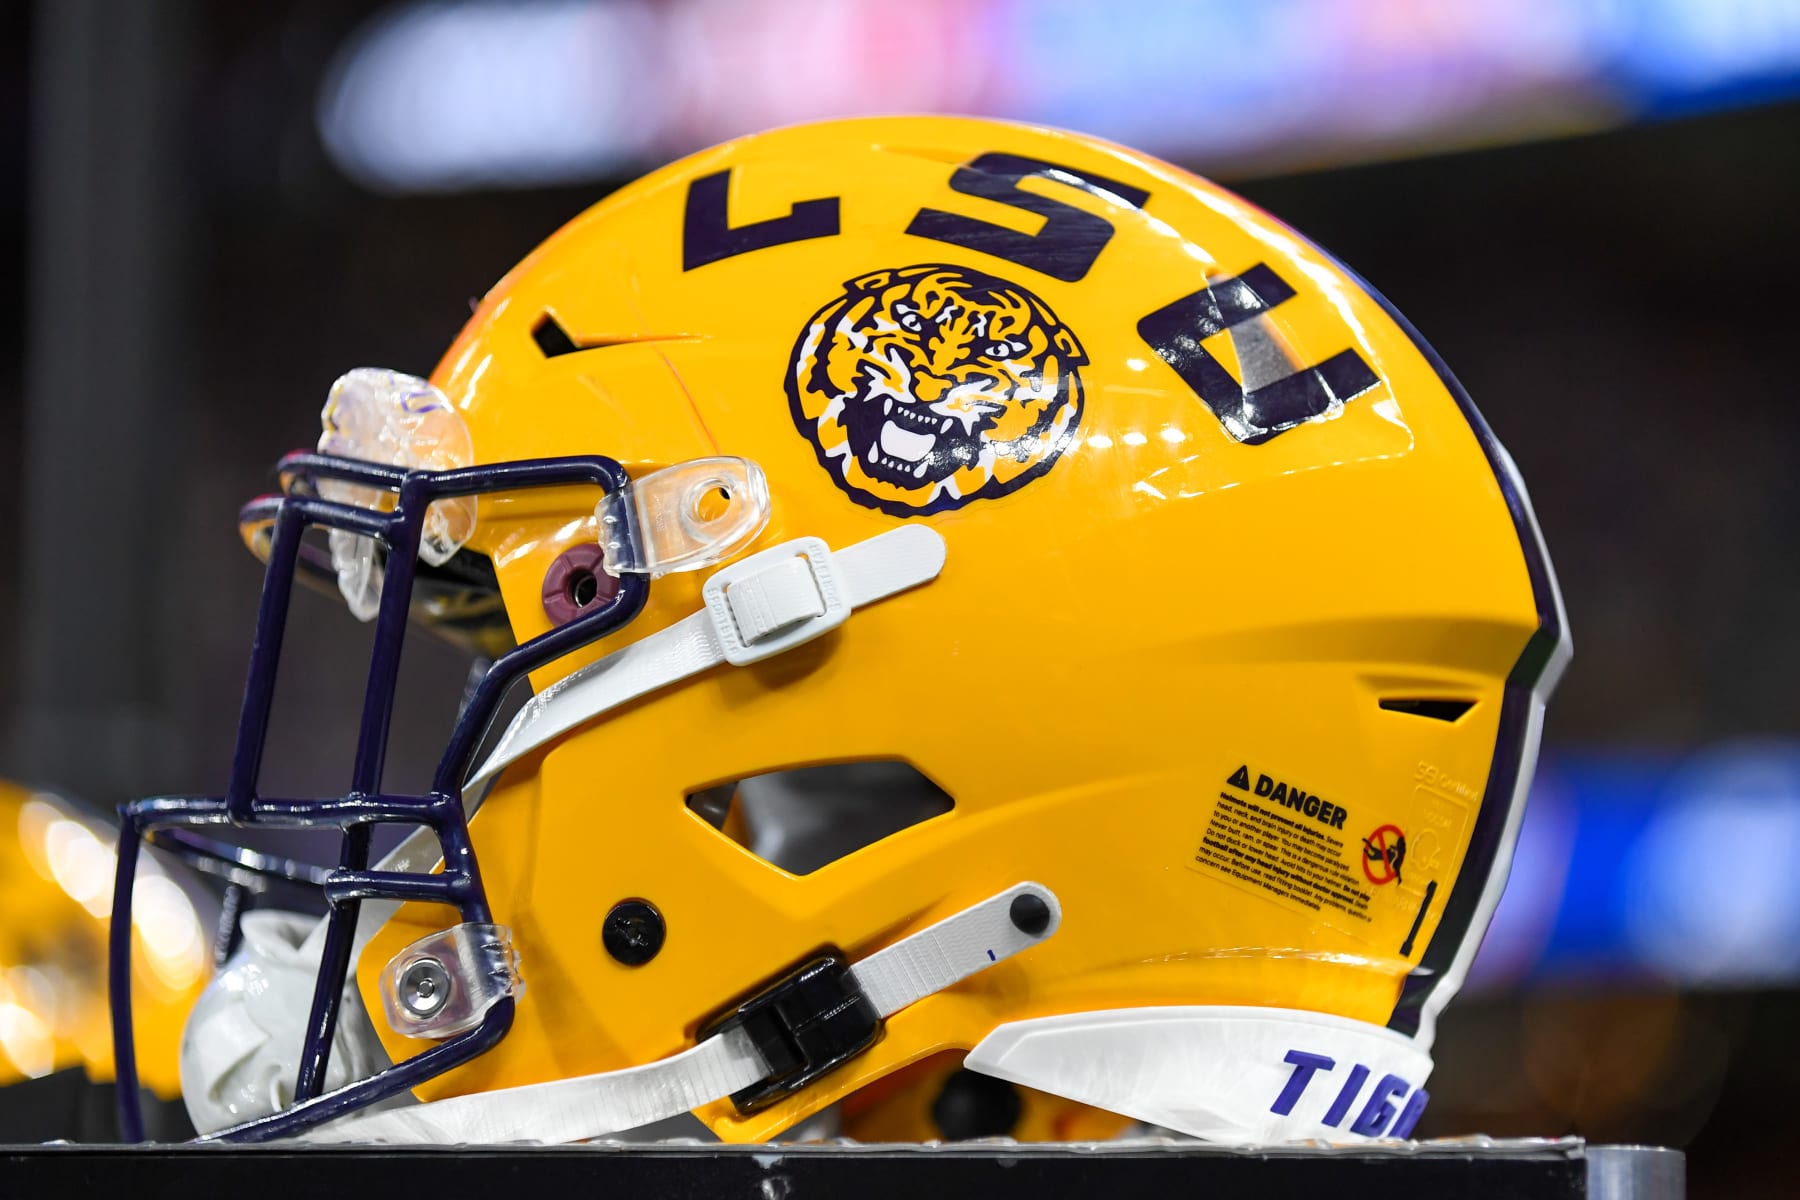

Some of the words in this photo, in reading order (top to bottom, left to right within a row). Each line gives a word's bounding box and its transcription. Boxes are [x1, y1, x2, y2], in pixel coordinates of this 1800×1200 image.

[683, 151, 1381, 446] LSU
[1220, 792, 1247, 808] Helmets
[1247, 804, 1260, 813] will
[1259, 809, 1271, 818] not
[1294, 823, 1303, 831] all
[1326, 836, 1344, 848] Severe
[1254, 774, 1347, 830] DANGER
[1210, 819, 1228, 830] Never
[1215, 832, 1226, 840] not
[1226, 836, 1241, 847] duck
[1248, 844, 1264, 856] lower
[1220, 814, 1232, 822] you
[1239, 821, 1262, 834] another
[1292, 843, 1304, 853] may
[1303, 847, 1325, 861] become
[1249, 815, 1263, 824] and
[1261, 819, 1276, 830] brain
[1300, 835, 1315, 846] death
[1315, 843, 1327, 852] may
[1195, 856, 1220, 869] concern
[1220, 865, 1232, 874] see
[1232, 869, 1263, 886] Equipment
[1199, 847, 1212, 857] may
[1231, 858, 1250, 871] Before
[1202, 836, 1229, 852] football
[1228, 848, 1245, 859] after
[1244, 854, 1257, 864] any
[1256, 858, 1273, 870] head
[1272, 865, 1290, 878] injury
[1290, 873, 1313, 887] without
[1313, 882, 1331, 894] doctor
